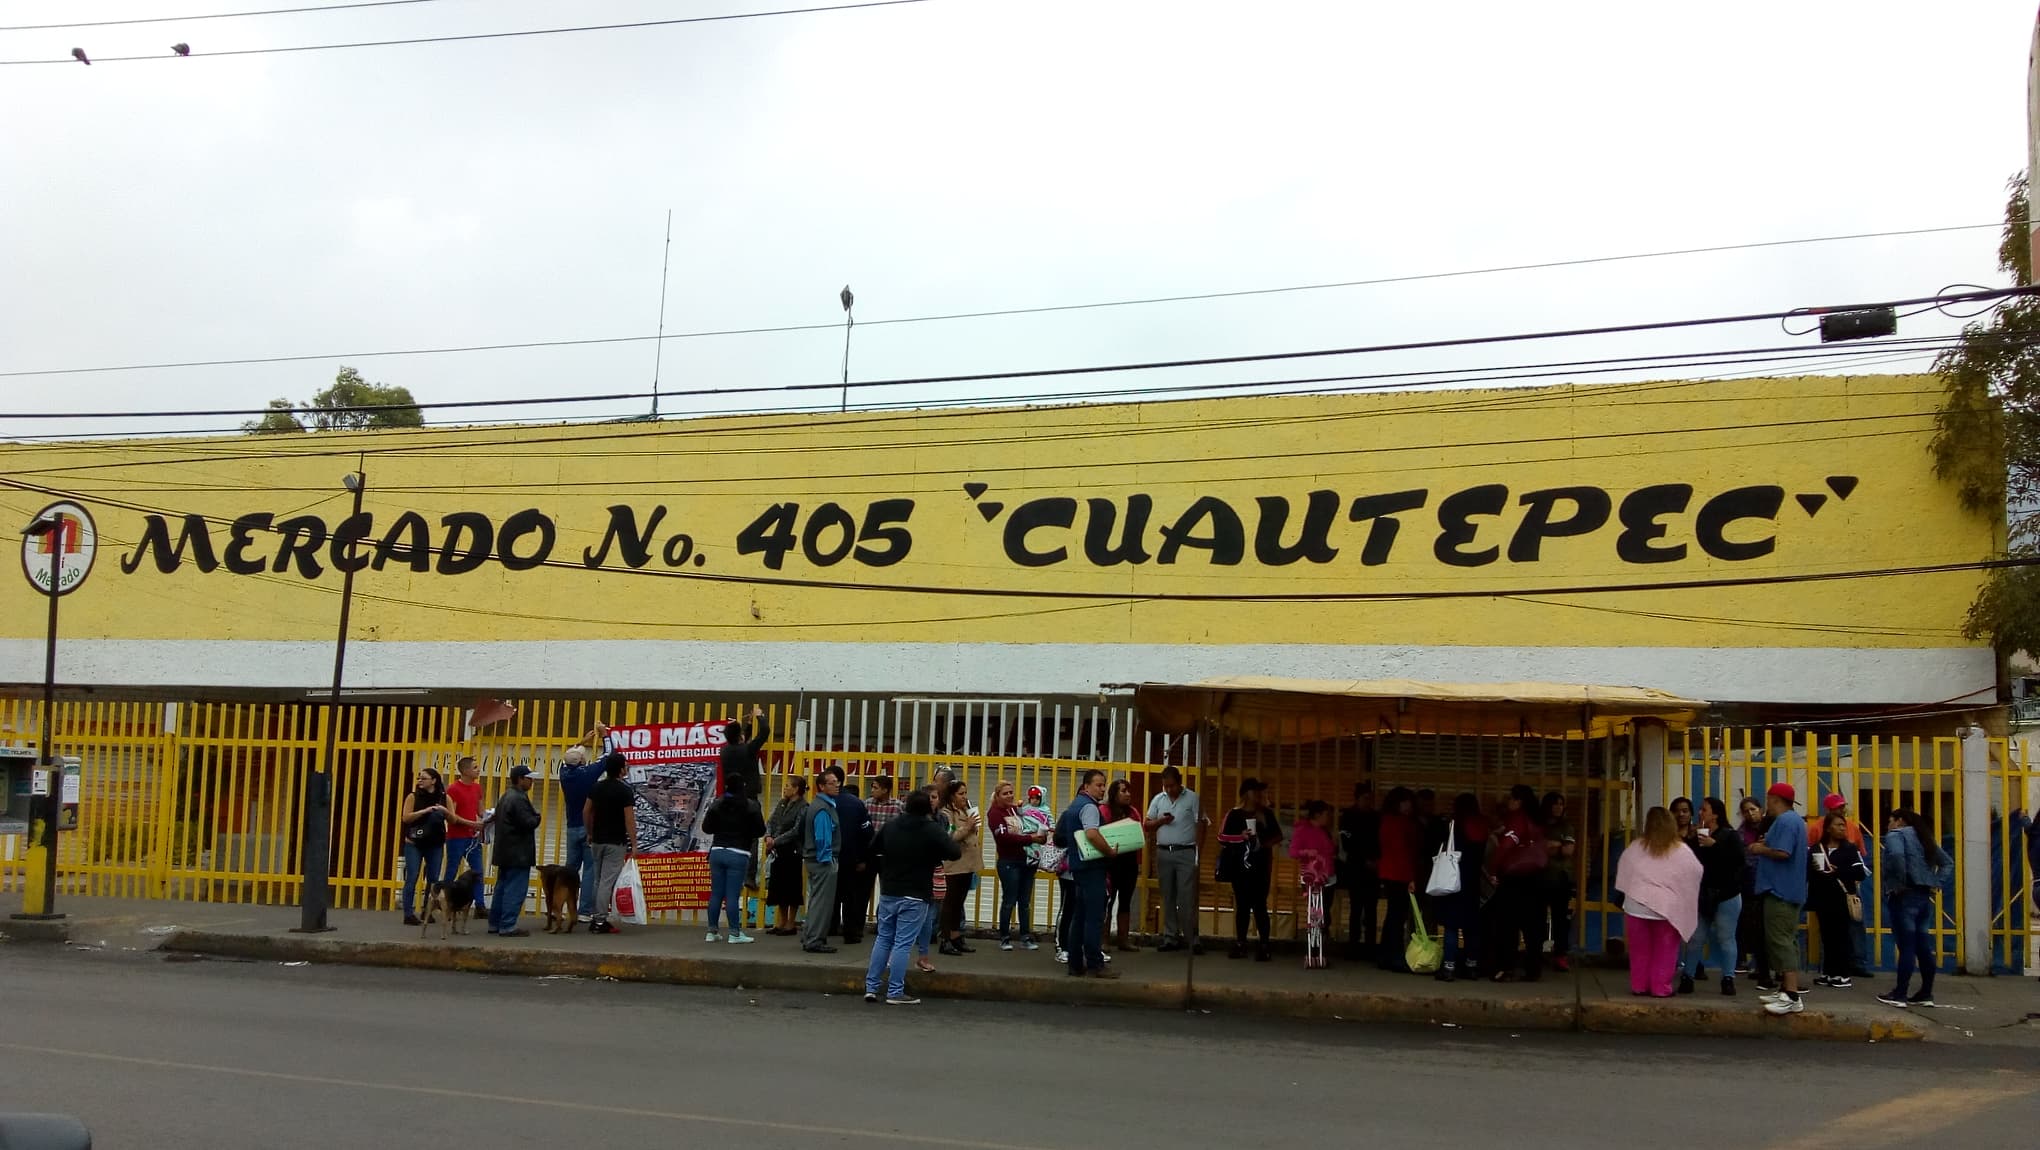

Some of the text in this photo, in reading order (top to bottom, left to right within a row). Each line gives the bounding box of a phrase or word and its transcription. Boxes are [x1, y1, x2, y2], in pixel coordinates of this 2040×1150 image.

[121, 508, 556, 579] MERCADO
[583, 504, 706, 569] No.
[736, 499, 915, 570] 405
[36, 567, 80, 586] Meado
[611, 723, 727, 749] NO MÁS
[618, 747, 721, 760] NTROS COMERCIALE
